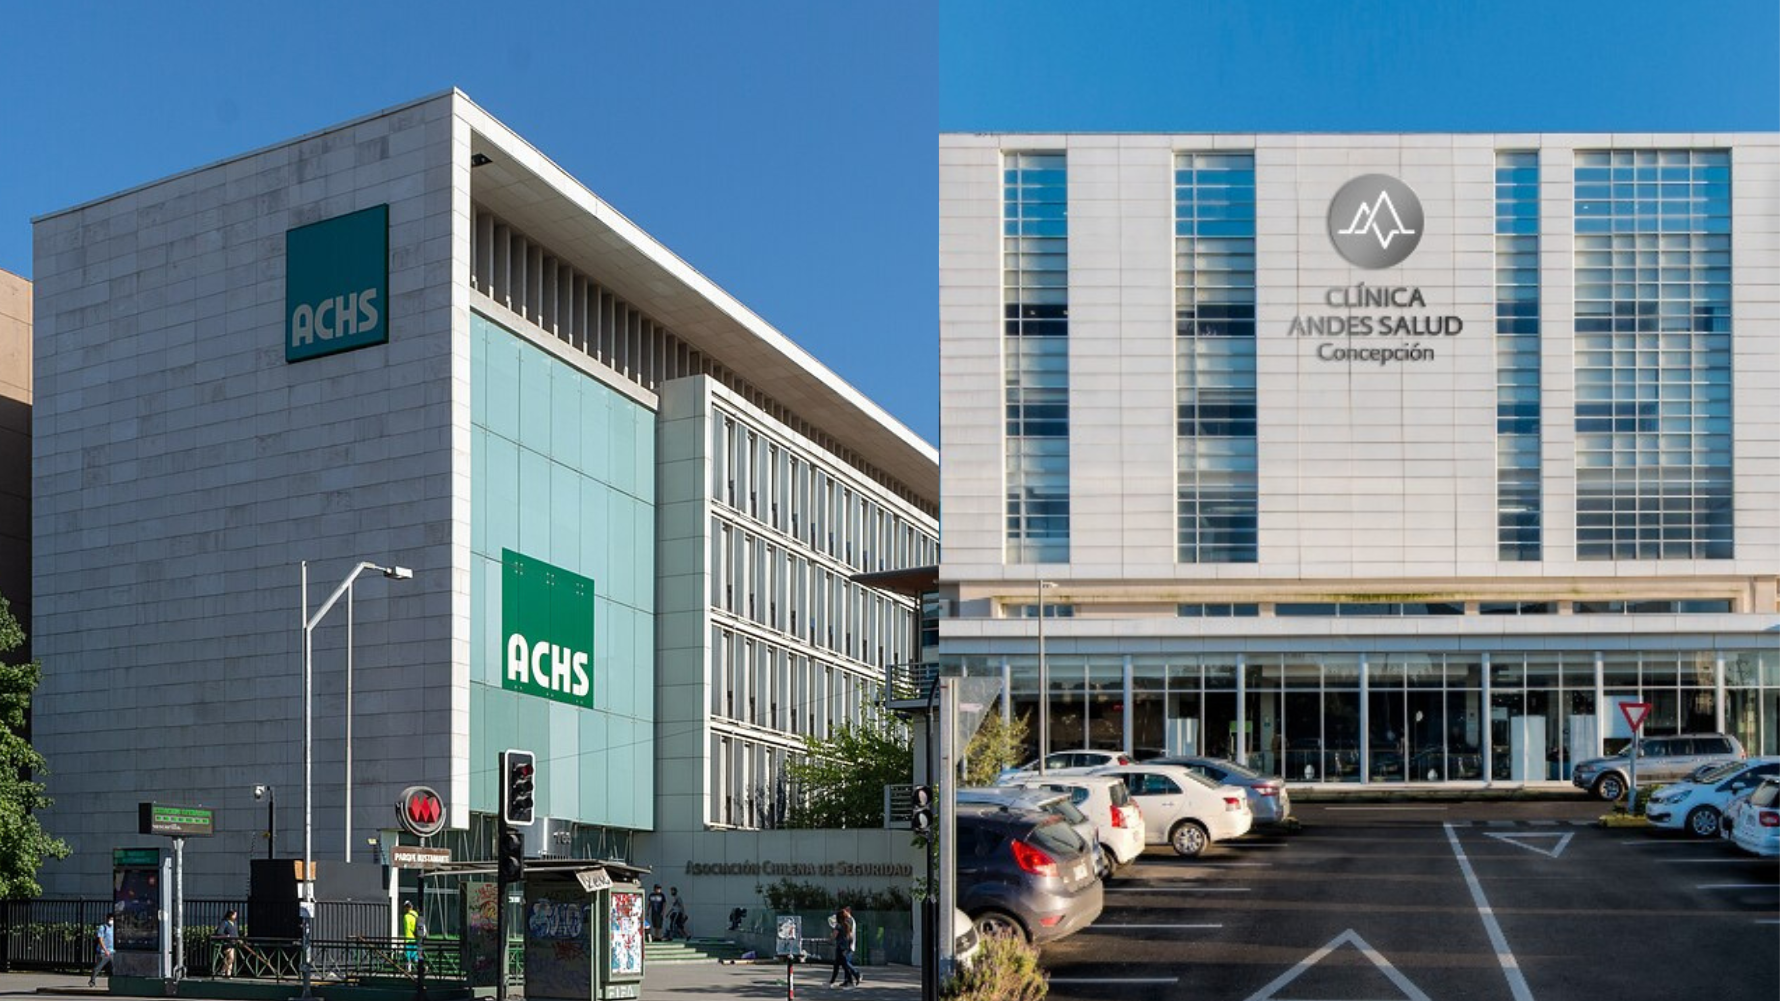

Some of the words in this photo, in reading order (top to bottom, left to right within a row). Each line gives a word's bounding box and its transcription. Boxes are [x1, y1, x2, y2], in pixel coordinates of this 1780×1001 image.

[1325, 281, 1427, 308] CLÍNICA
[291, 287, 379, 347] ACHS
[1287, 315, 1374, 336] ANDES
[1379, 315, 1463, 336] SALUD
[1316, 343, 1435, 366] Concepción
[506, 633, 590, 697] ACHS
